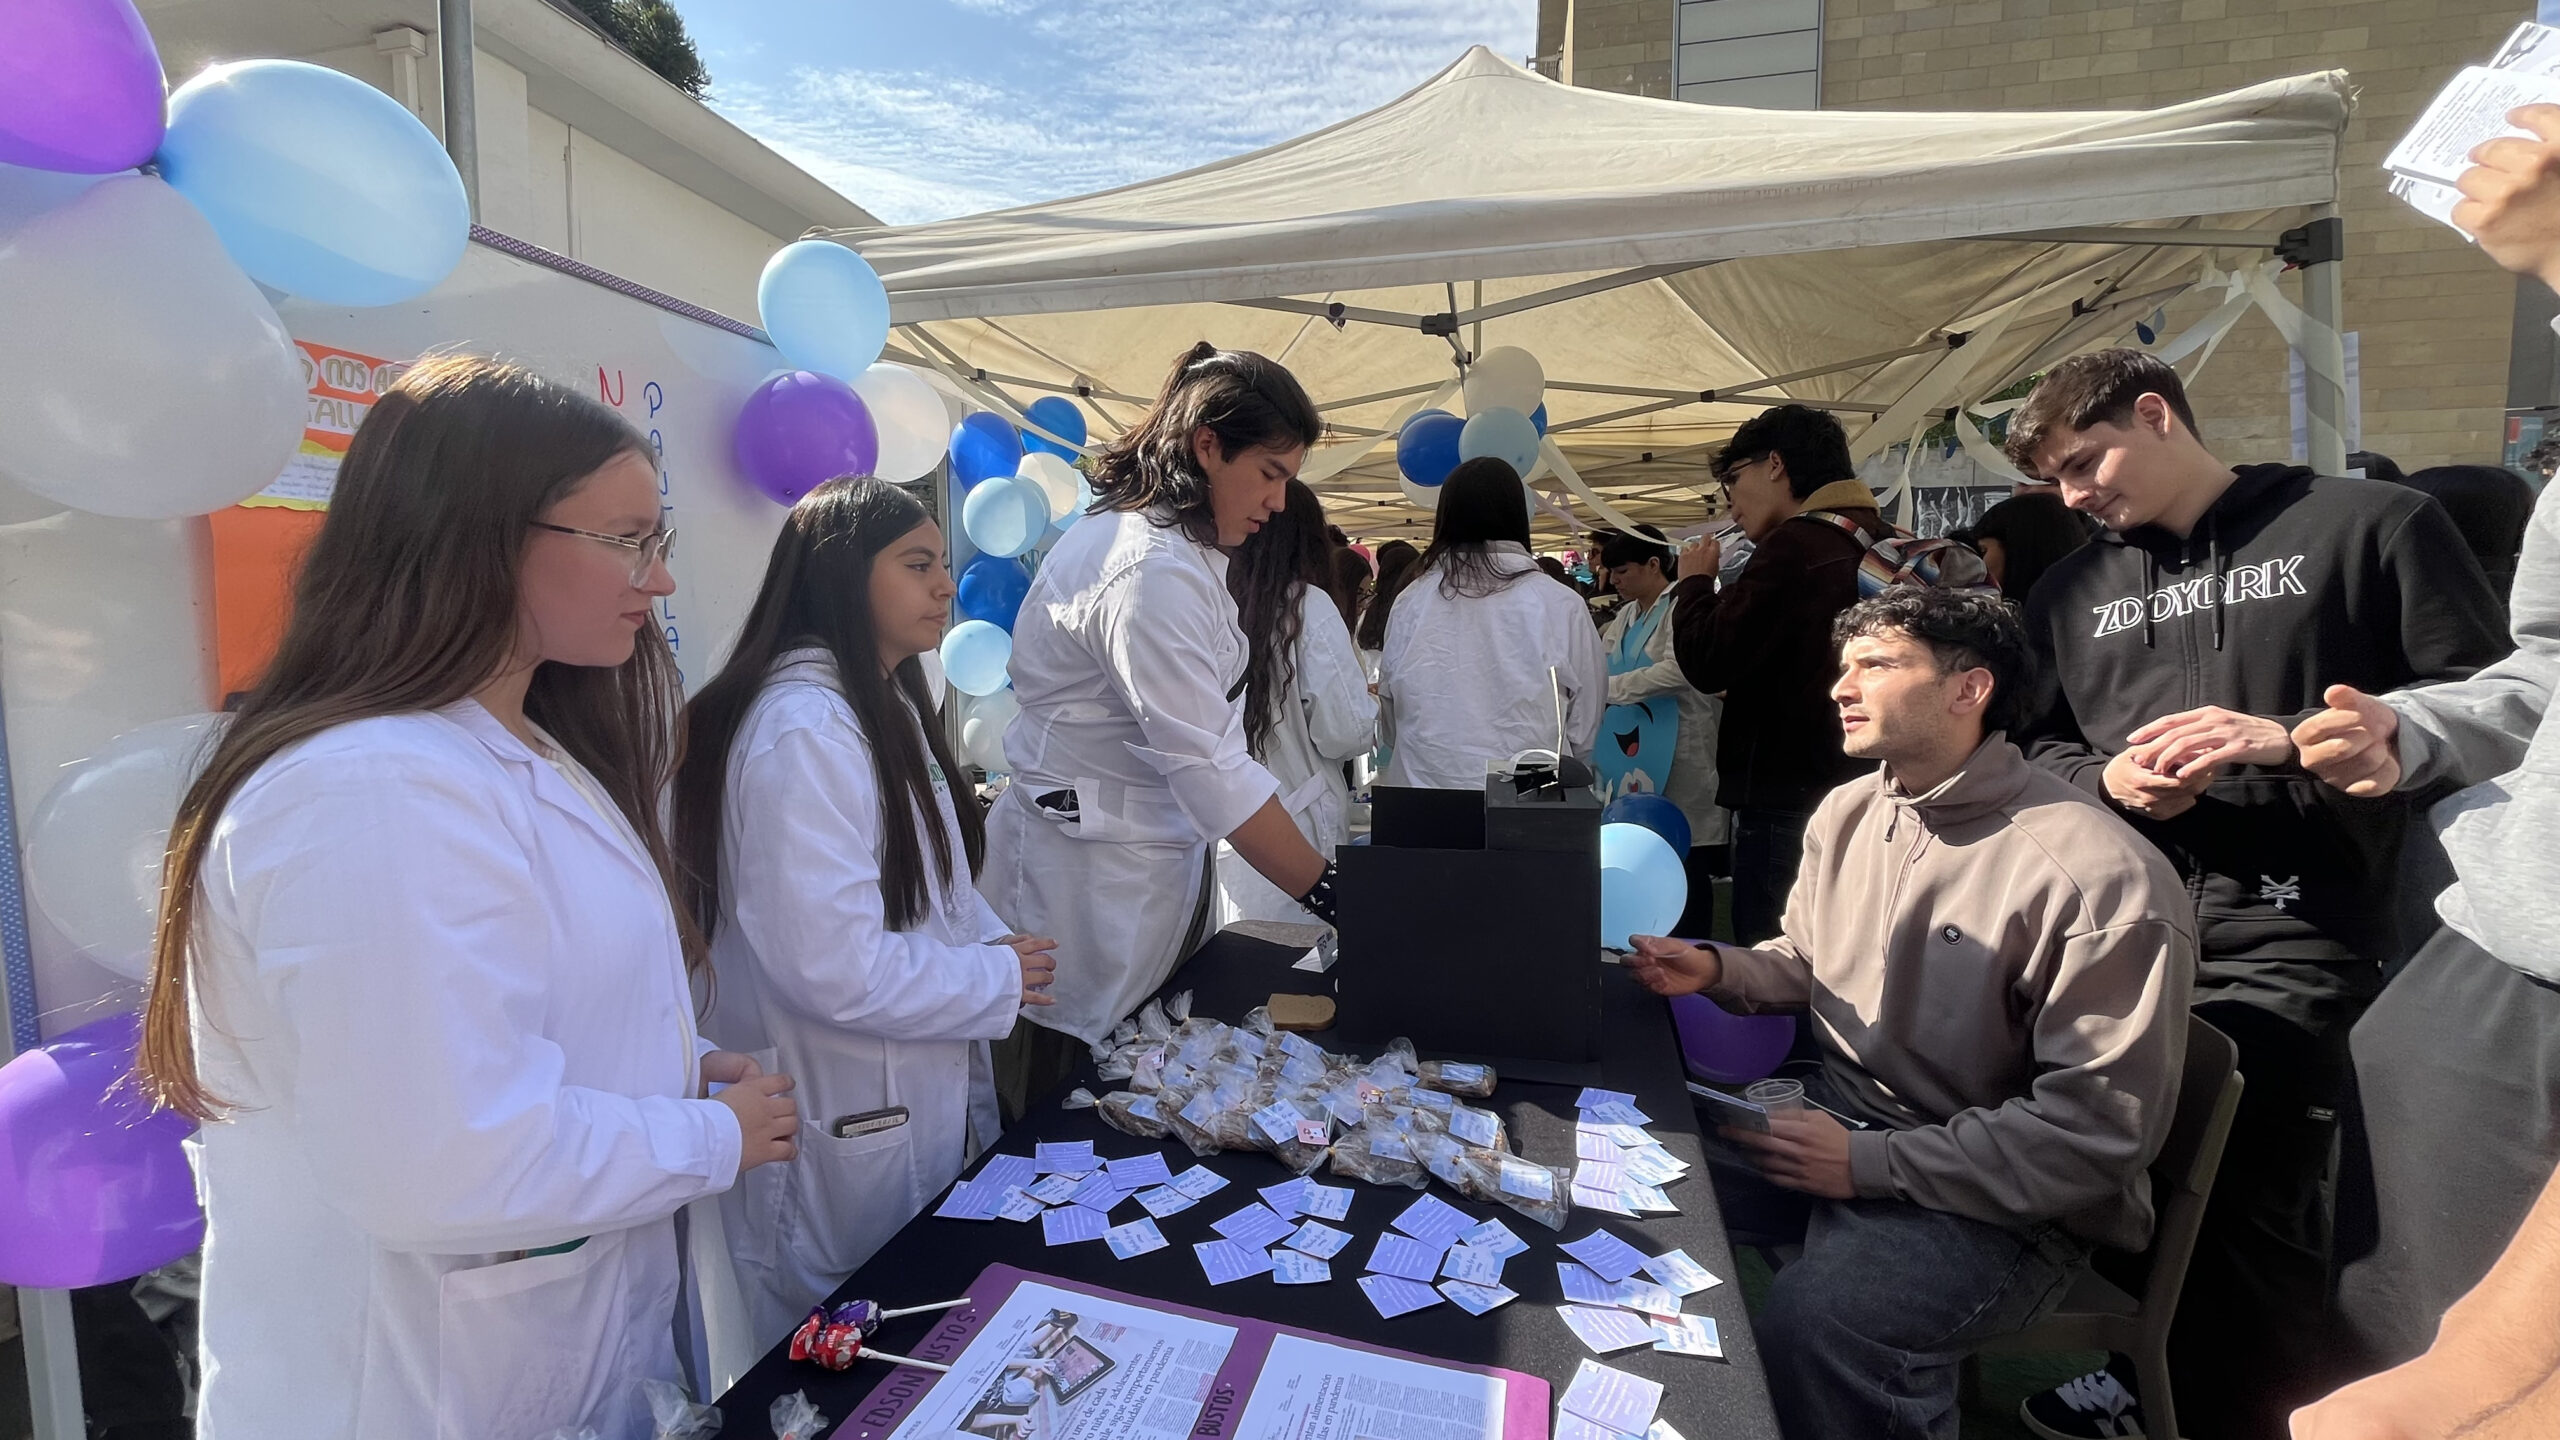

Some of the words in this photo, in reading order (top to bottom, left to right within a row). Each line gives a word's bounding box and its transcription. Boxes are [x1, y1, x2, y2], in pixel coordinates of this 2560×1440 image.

[325, 358, 367, 391] NOS
[860, 1373, 926, 1428] EDSON
[921, 1312, 977, 1361] USTOS
[1109, 1404, 1128, 1428] sigue
[1123, 1339, 1167, 1404] comportamientos
[1110, 1353, 1143, 1401] adolescentes
[1119, 1395, 1148, 1435] saludable
[1142, 1384, 1155, 1396] en
[1149, 1346, 1176, 1385] pandemia
[1071, 1418, 1088, 1436] uno
[1082, 1406, 1096, 1419] de
[1091, 1387, 1108, 1407] cada
[1105, 1400, 1117, 1409] y
[1196, 1388, 1235, 1436] BUSTOS
[1310, 1374, 1332, 1421] alimentación
[1324, 1414, 1334, 1425] en
[1327, 1377, 1345, 1415] pandemia
[1090, 1407, 1111, 1434] niños
